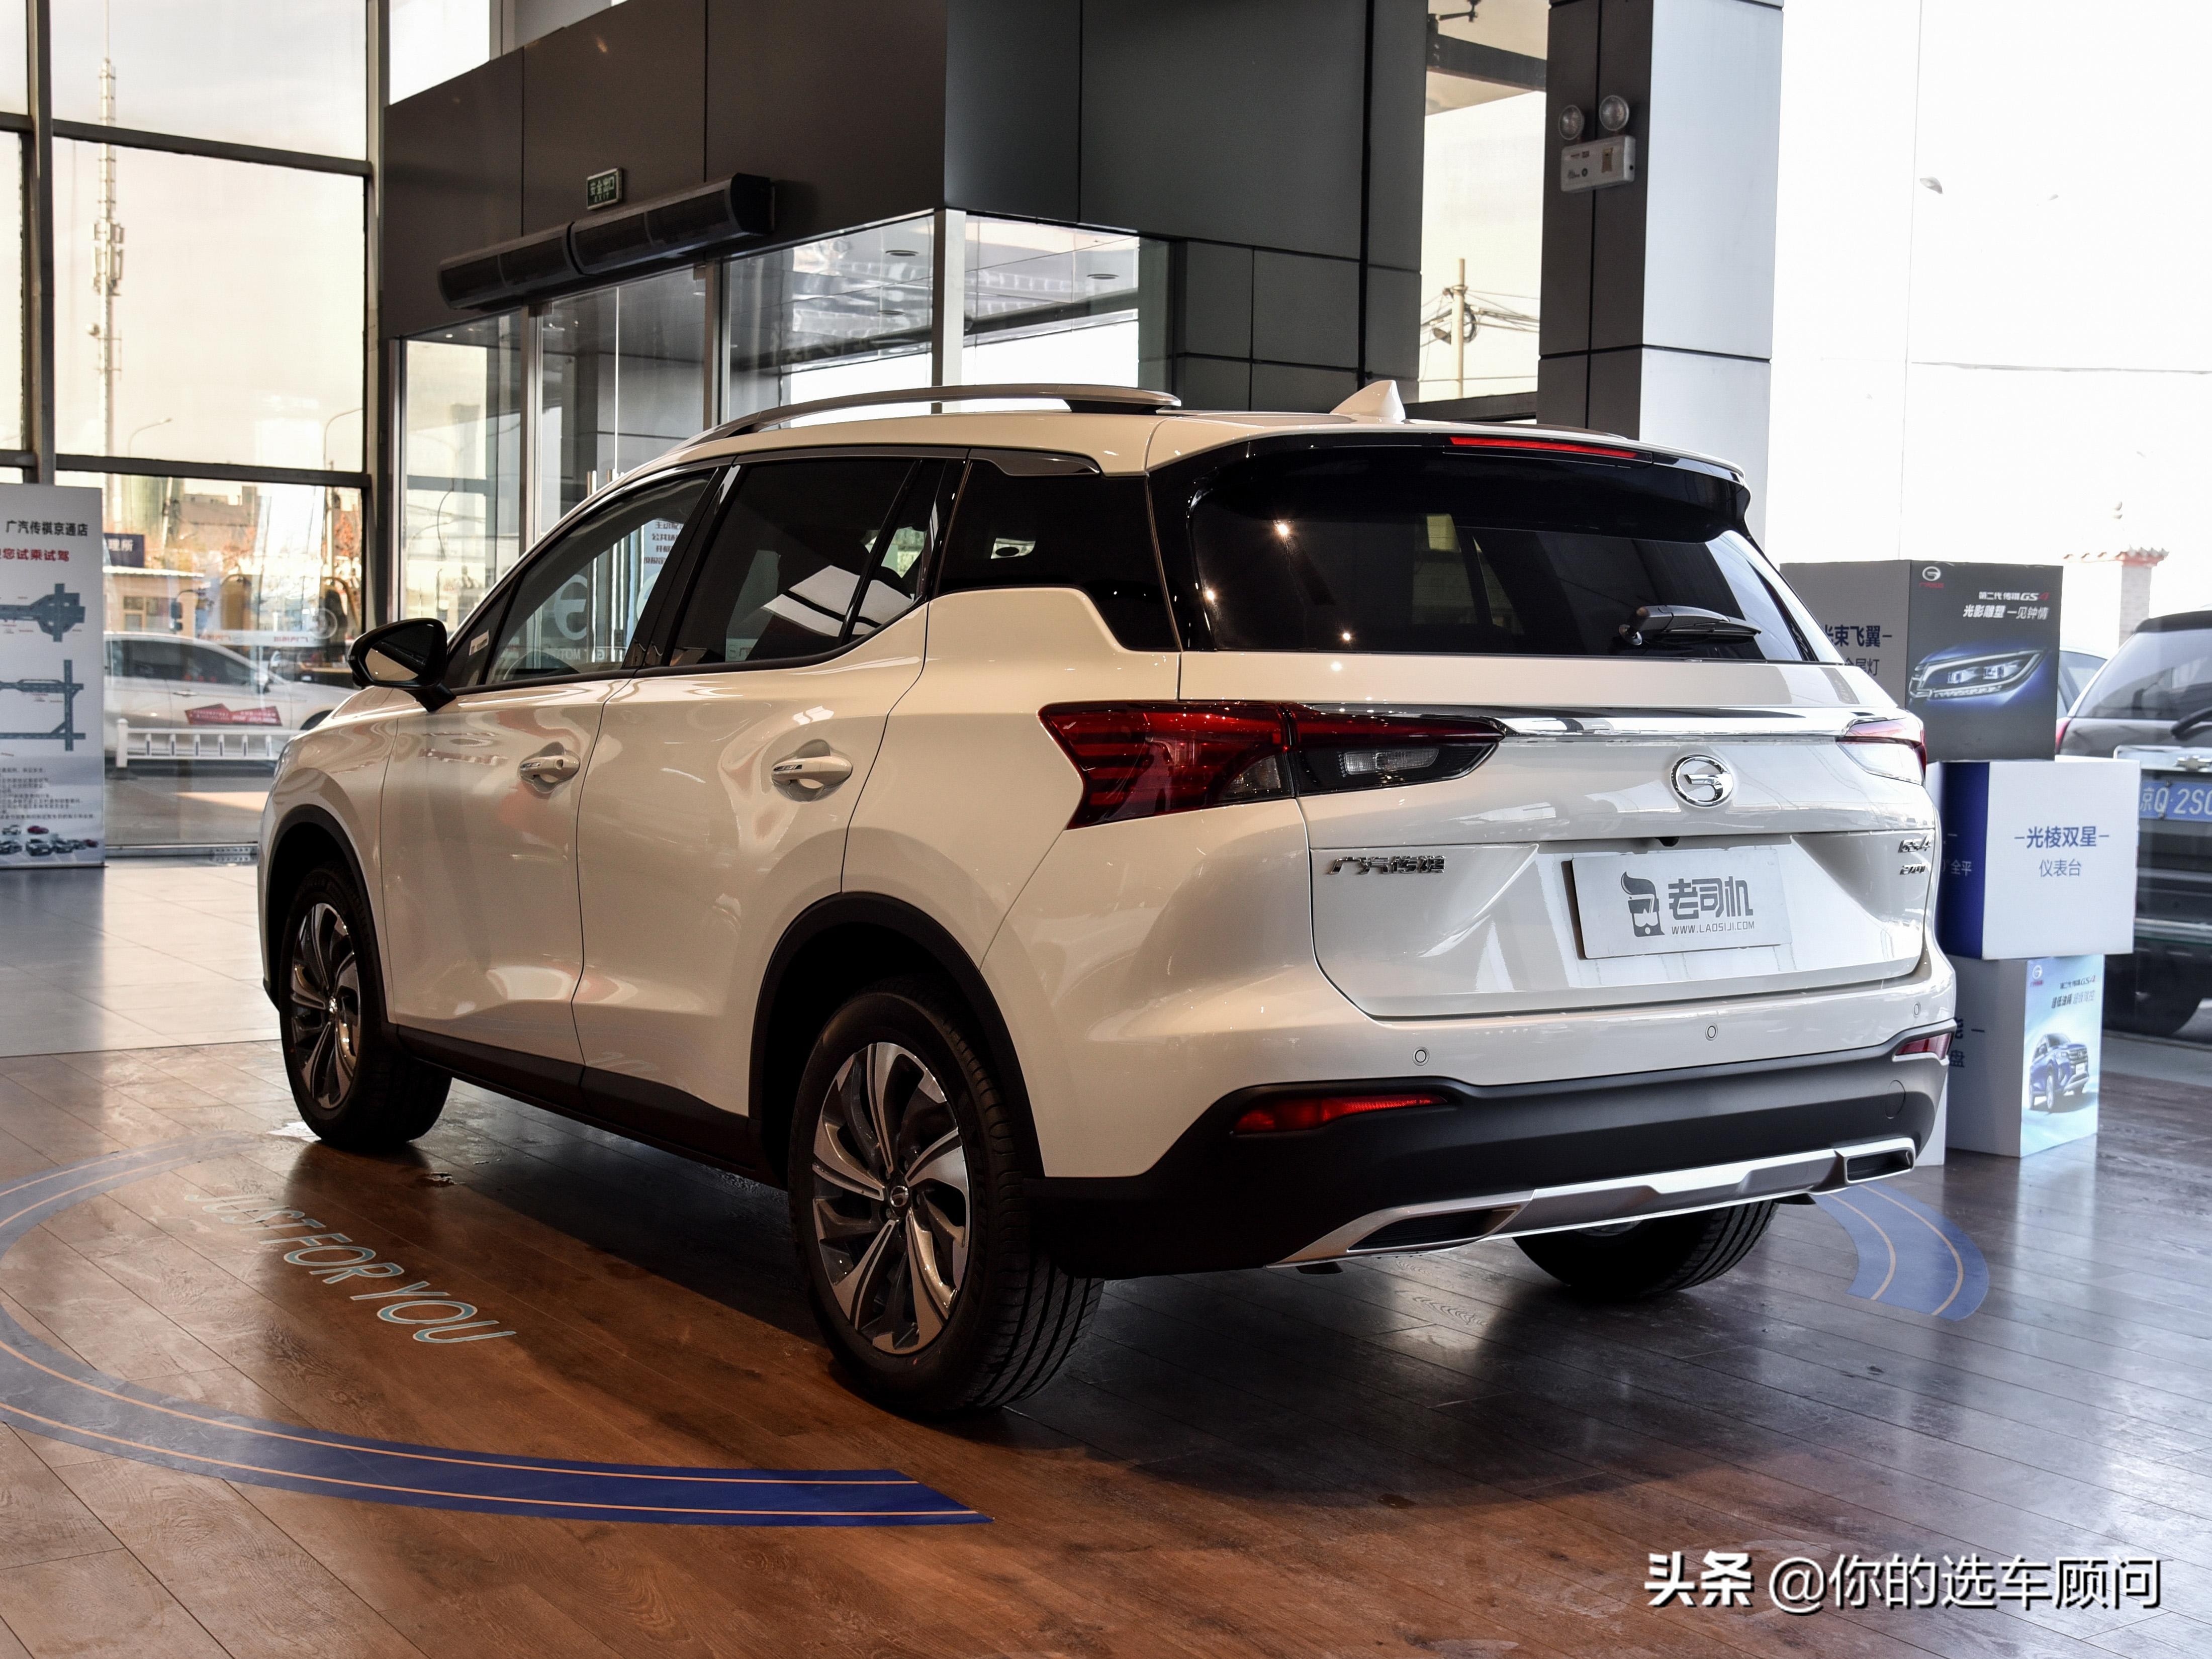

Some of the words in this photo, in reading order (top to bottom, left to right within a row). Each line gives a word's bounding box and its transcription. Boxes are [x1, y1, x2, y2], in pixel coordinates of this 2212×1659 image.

[590, 176, 614, 196] 安全出口
[6, 520, 88, 536] 广汽传祺京通店
[0, 548, 70, 562] 您试乘试驾
[1963, 604, 2006, 618] 光影雕塑
[2007, 606, 2050, 620] 一见钟情
[1328, 856, 1445, 875] 广汽传祺
[2039, 859, 2081, 877] 仪表台
[1668, 876, 1754, 920] 老司机
[1672, 921, 1755, 935] WWW.LAOSIJI.COM
[184, 1193, 326, 1232] JUST
[258, 1232, 405, 1284] FOR
[349, 1280, 517, 1344] YOU
